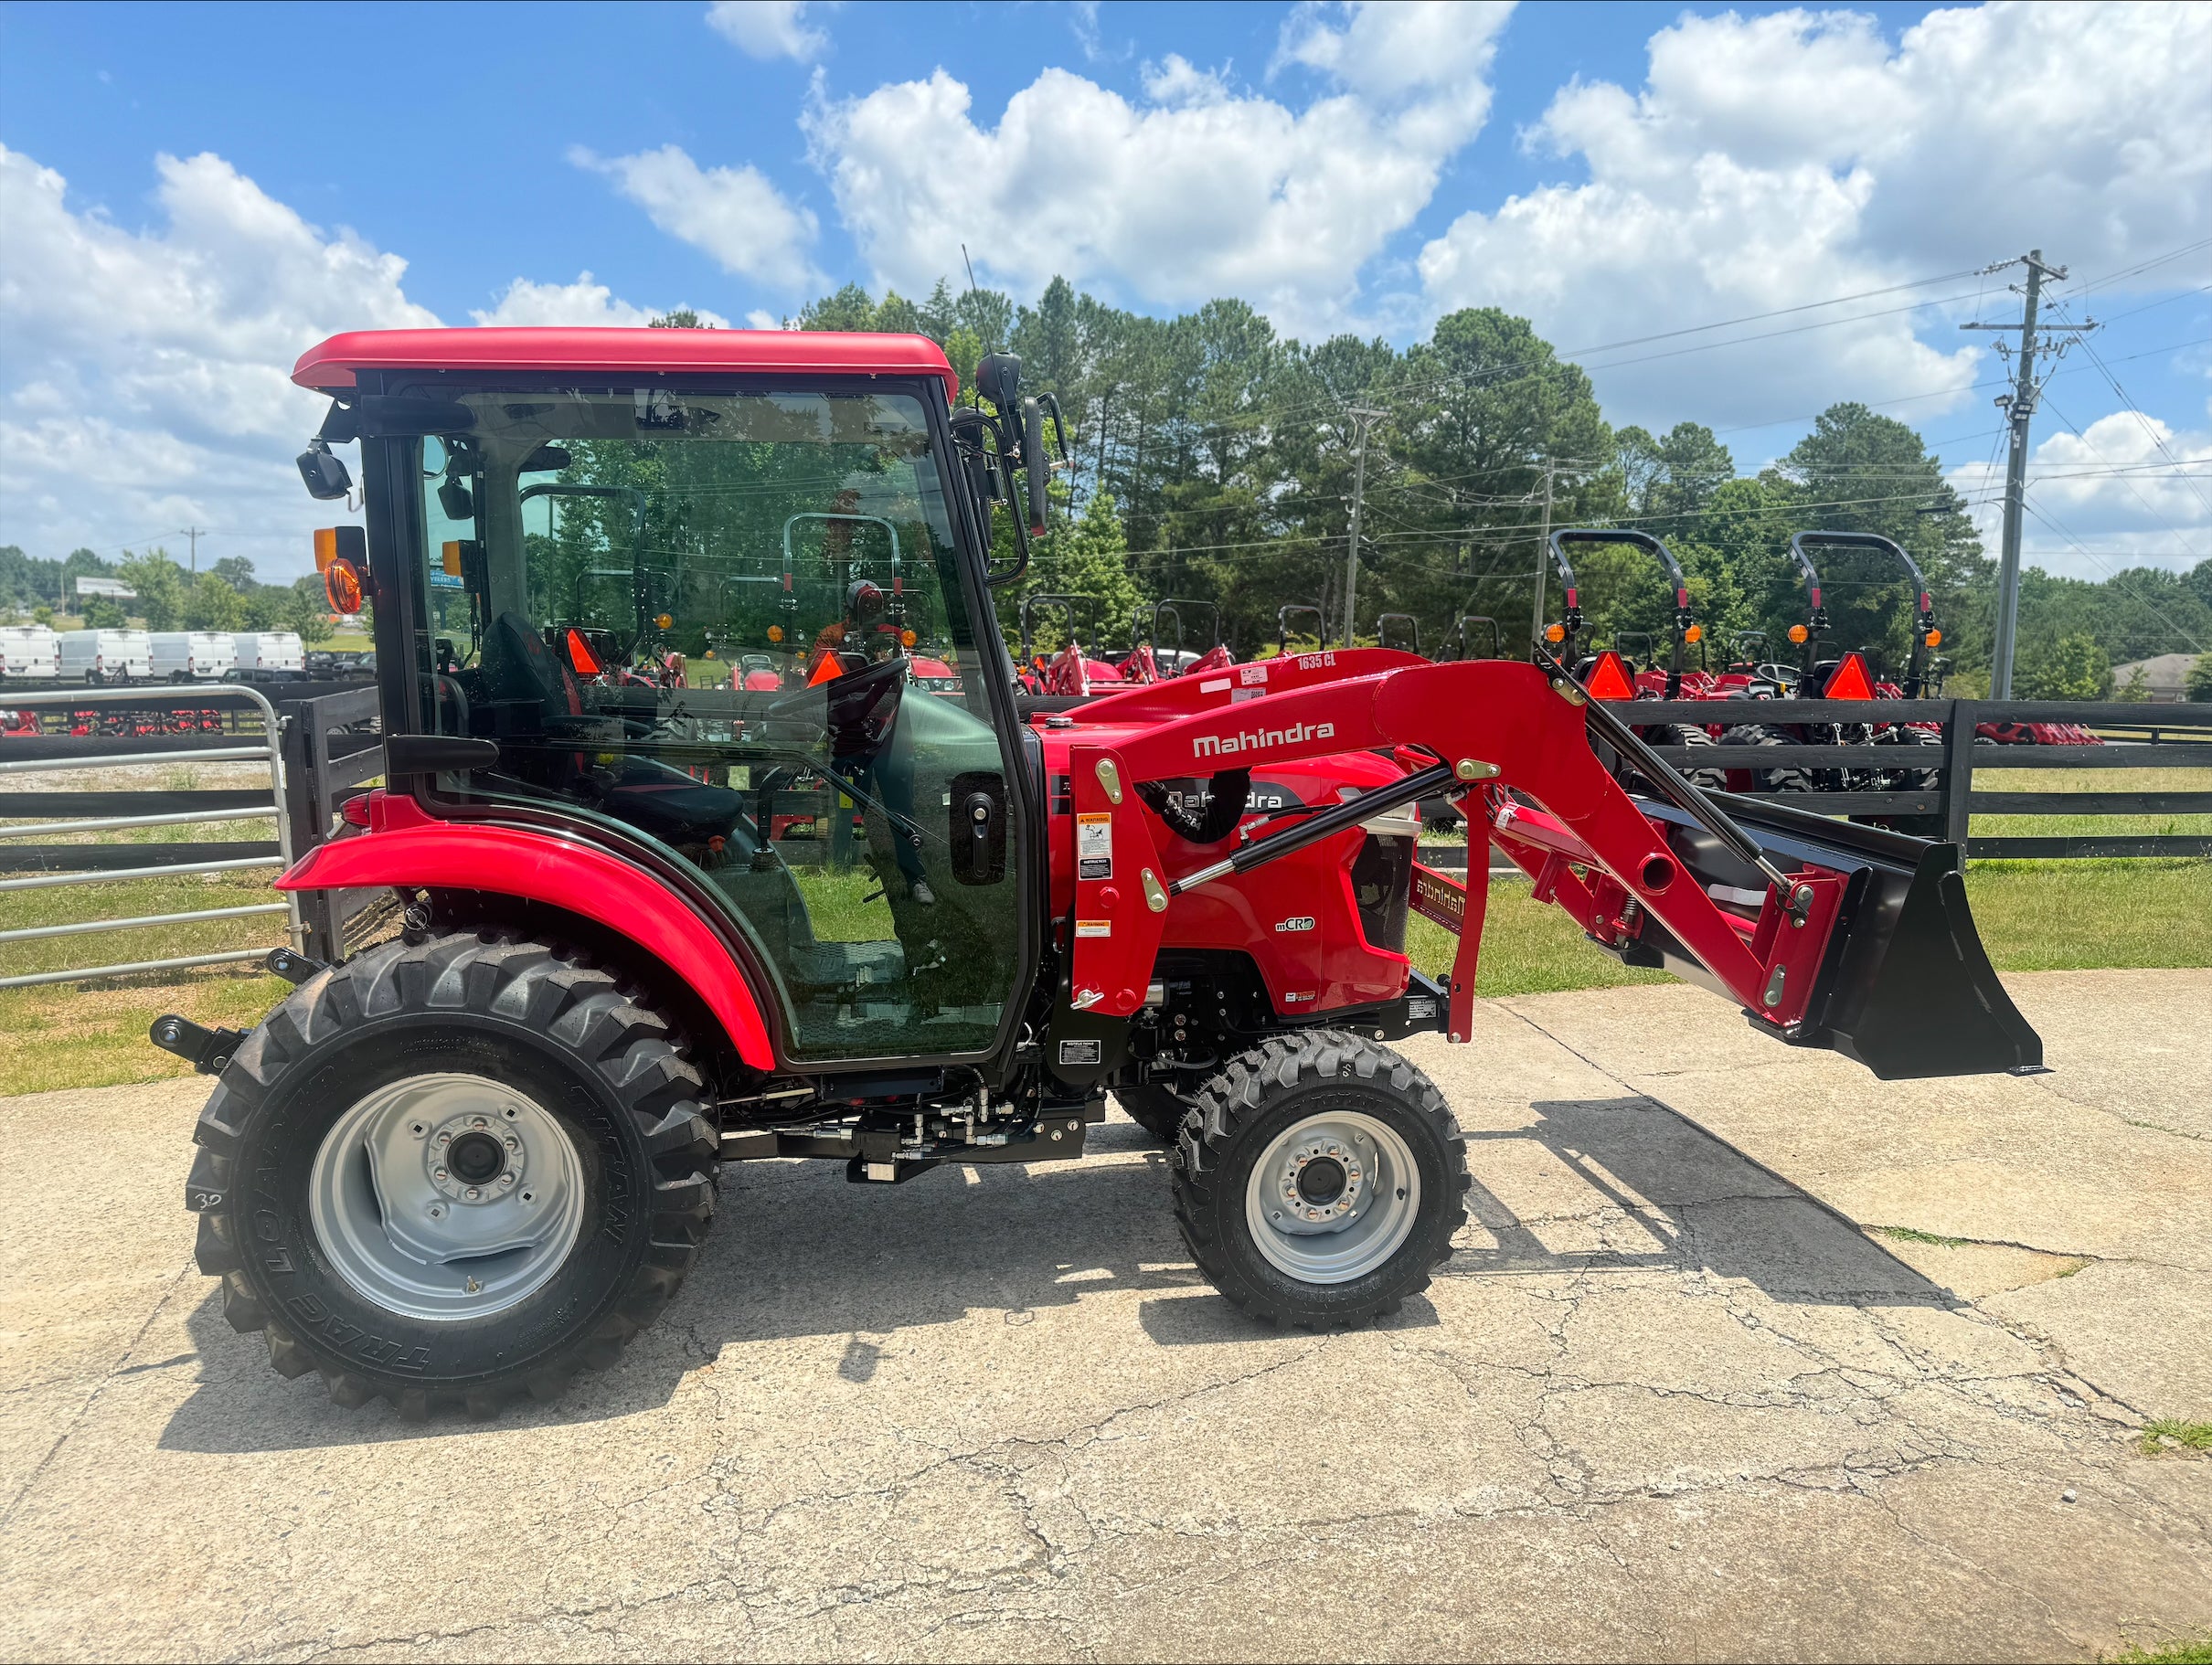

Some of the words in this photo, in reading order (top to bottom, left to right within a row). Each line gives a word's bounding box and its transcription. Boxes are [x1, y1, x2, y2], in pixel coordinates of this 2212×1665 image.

[1298, 655, 1323, 671] 1635
[1324, 652, 1336, 667] CL
[1193, 722, 1335, 758] Mahindra
